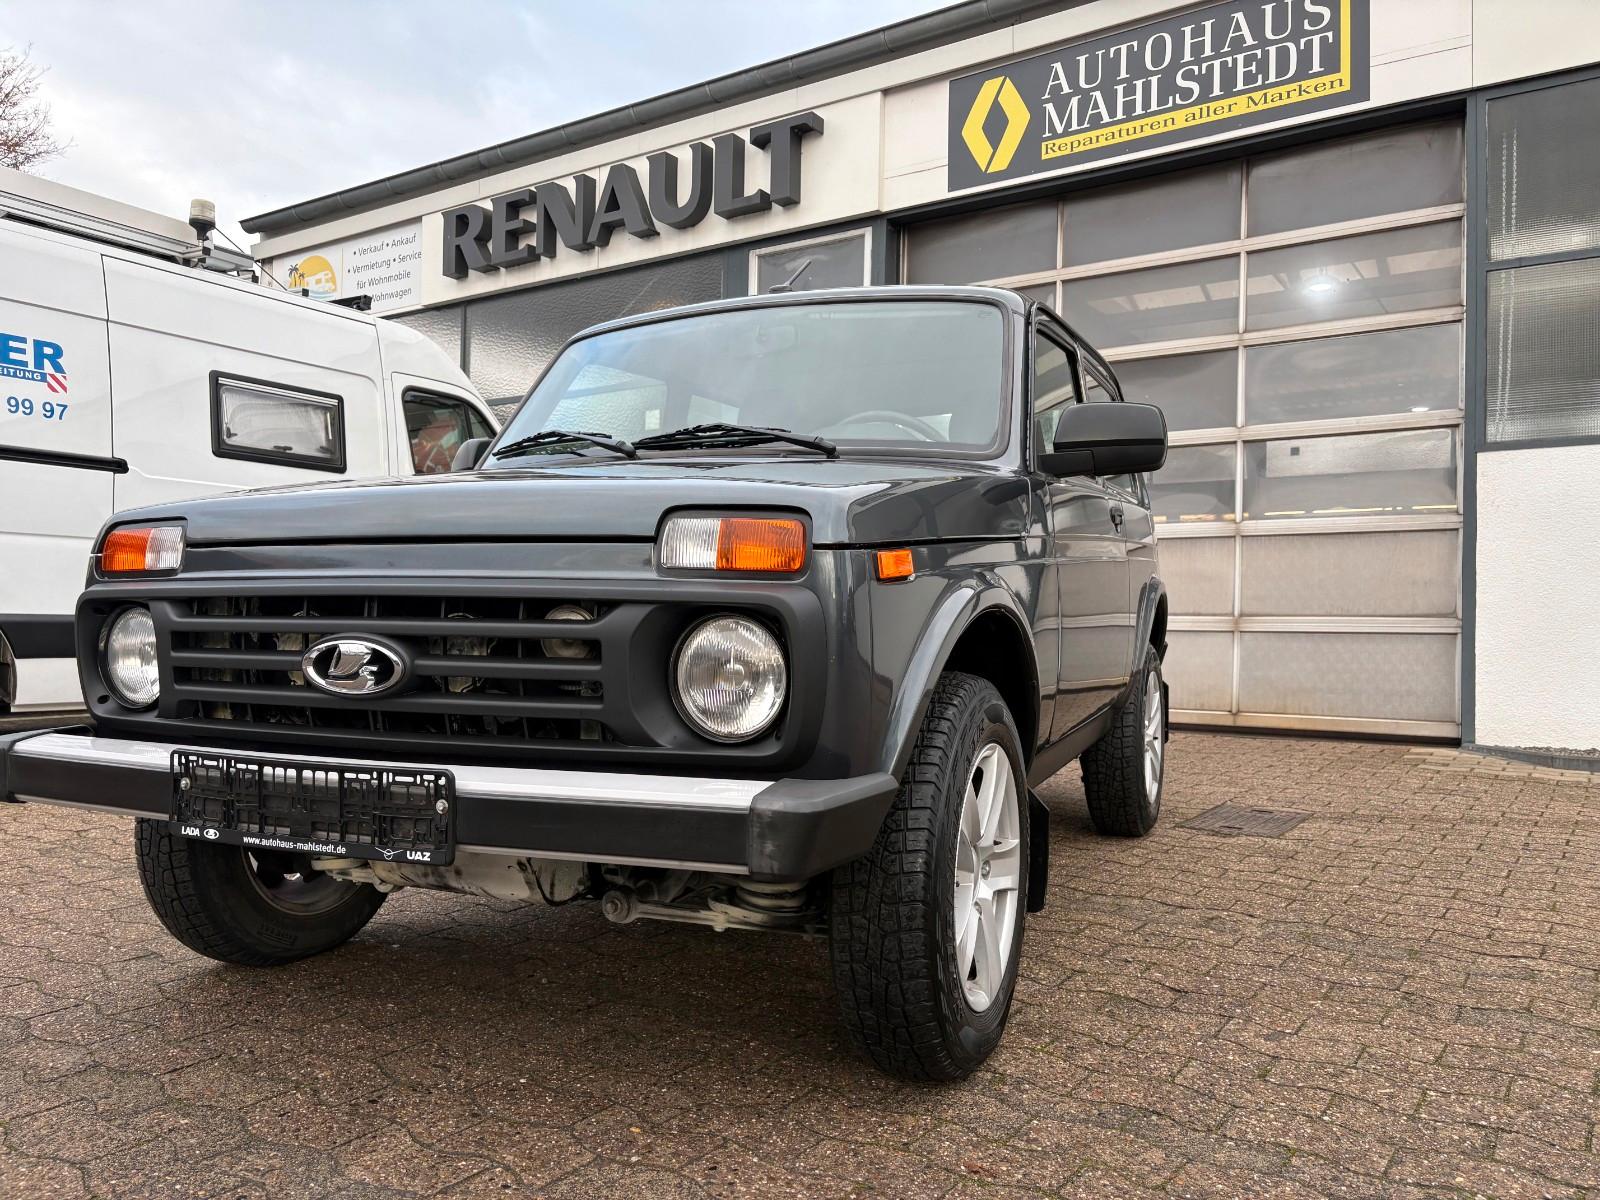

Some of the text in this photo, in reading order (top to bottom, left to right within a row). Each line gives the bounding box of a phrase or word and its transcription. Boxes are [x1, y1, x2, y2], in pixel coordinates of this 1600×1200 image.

[1041, 0, 1332, 99] AUTOHAUS
[1042, 31, 1333, 137] MAHLSTEDT
[1043, 76, 1345, 156] Reparaturen aller Marken
[442, 111, 824, 280] RENAULT
[358, 233, 417, 256] Verkauf Ankauf
[352, 250, 422, 274] Vermietung Service
[356, 270, 411, 290] für Wohnmobile
[0, 333, 67, 374] ER
[6, 396, 69, 420] 99 97
[181, 825, 200, 837] LADA
[243, 835, 346, 855] www.autohaus-mahlstedt.de
[406, 850, 431, 862] UAZ
